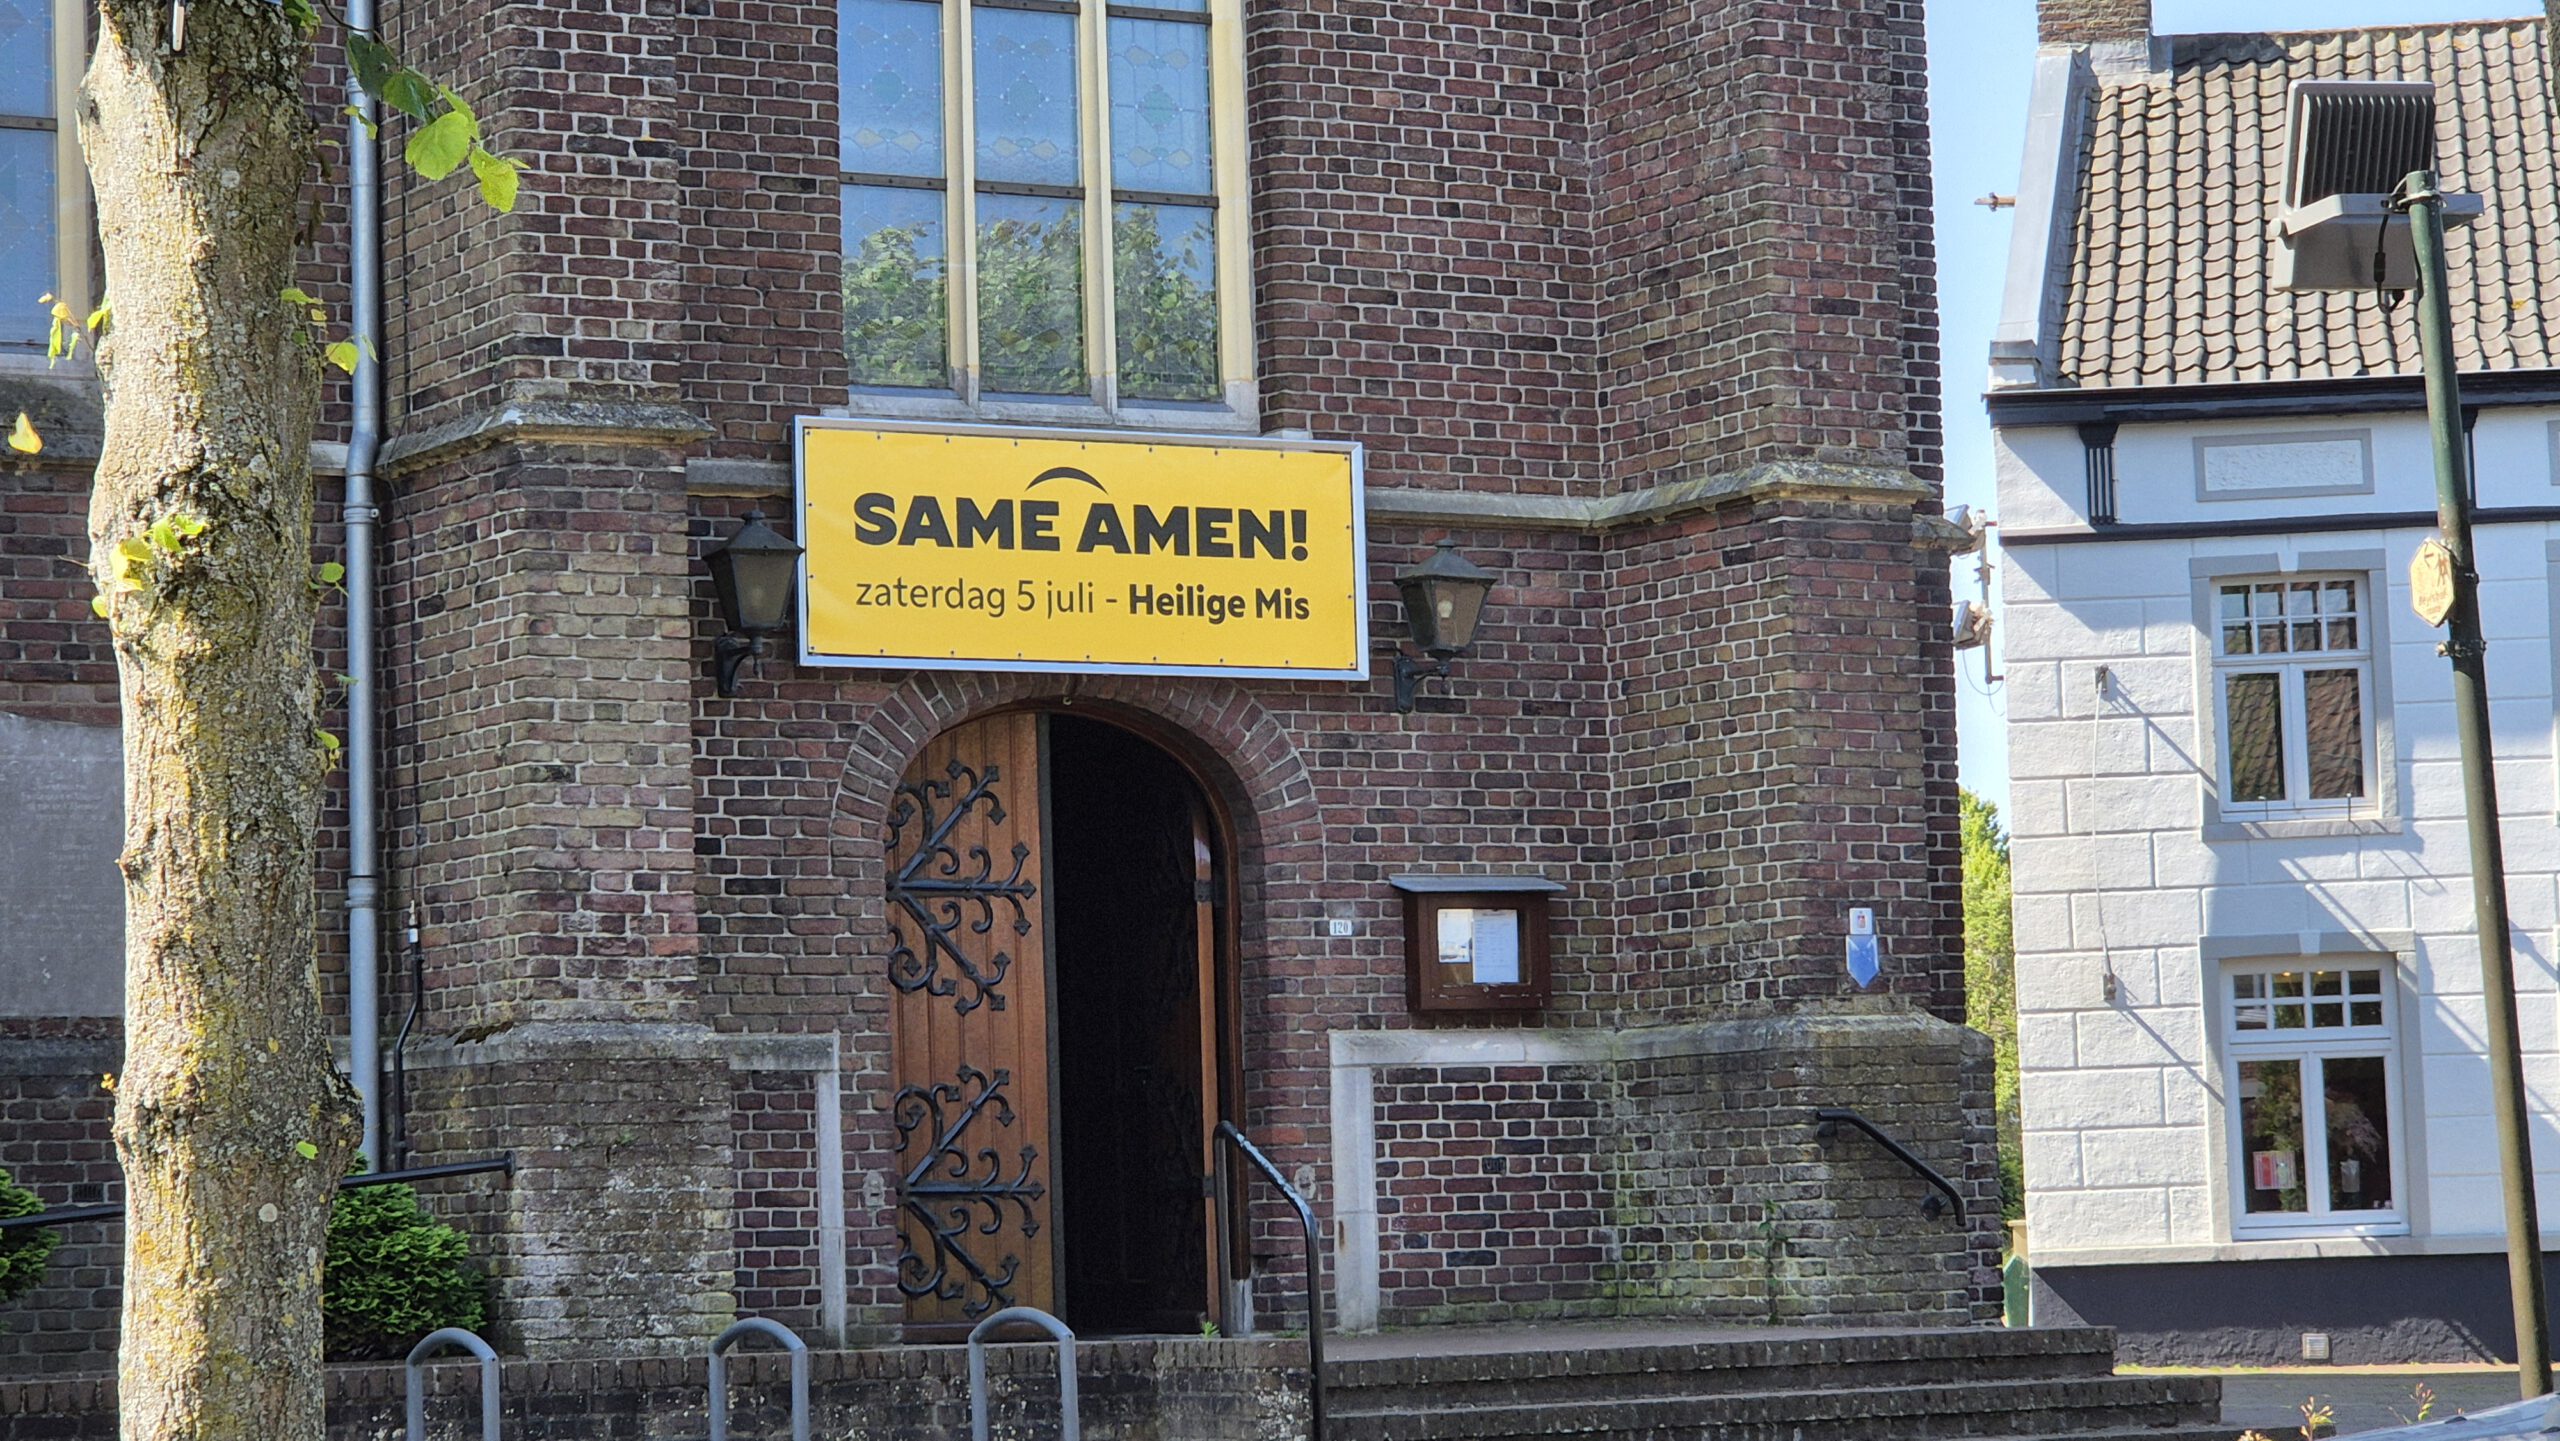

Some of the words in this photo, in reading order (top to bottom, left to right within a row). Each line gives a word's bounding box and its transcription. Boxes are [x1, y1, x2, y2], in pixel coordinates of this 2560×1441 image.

[853, 492, 1061, 552] SAME
[1076, 502, 1309, 562] AMEN!
[856, 577, 1006, 618] zaterdag
[1017, 580, 1035, 612] 5
[1046, 582, 1094, 620] juli
[1129, 583, 1246, 625] Heilige
[1255, 587, 1310, 620] Mis
[1331, 920, 1349, 935] 120
